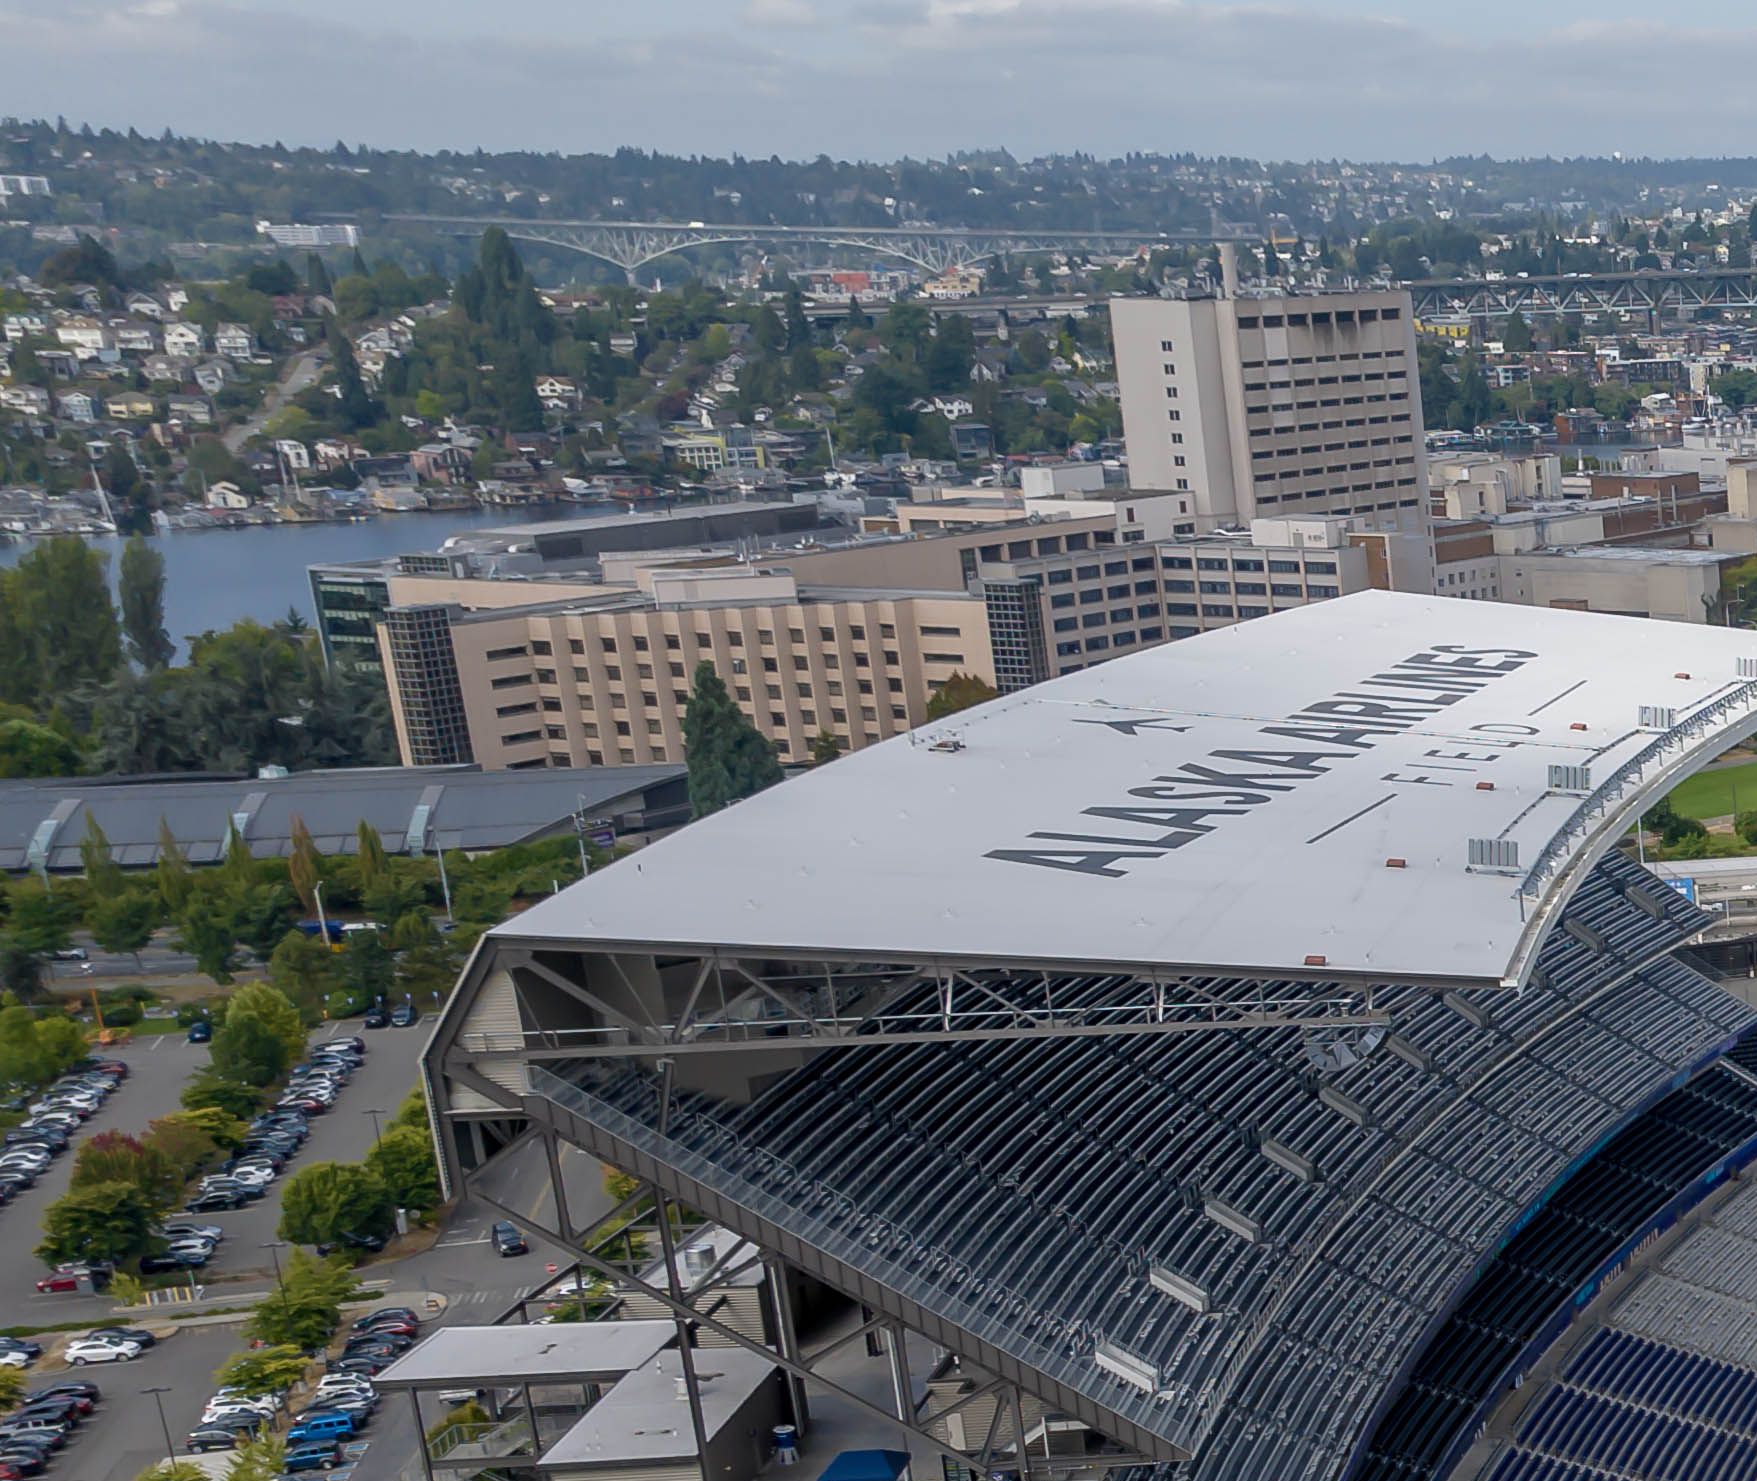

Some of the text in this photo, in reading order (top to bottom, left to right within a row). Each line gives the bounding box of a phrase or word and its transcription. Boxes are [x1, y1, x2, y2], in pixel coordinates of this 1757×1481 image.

[984, 644, 1538, 878] ALASKA AIRLINES
[1380, 723, 1541, 787] FIELD
